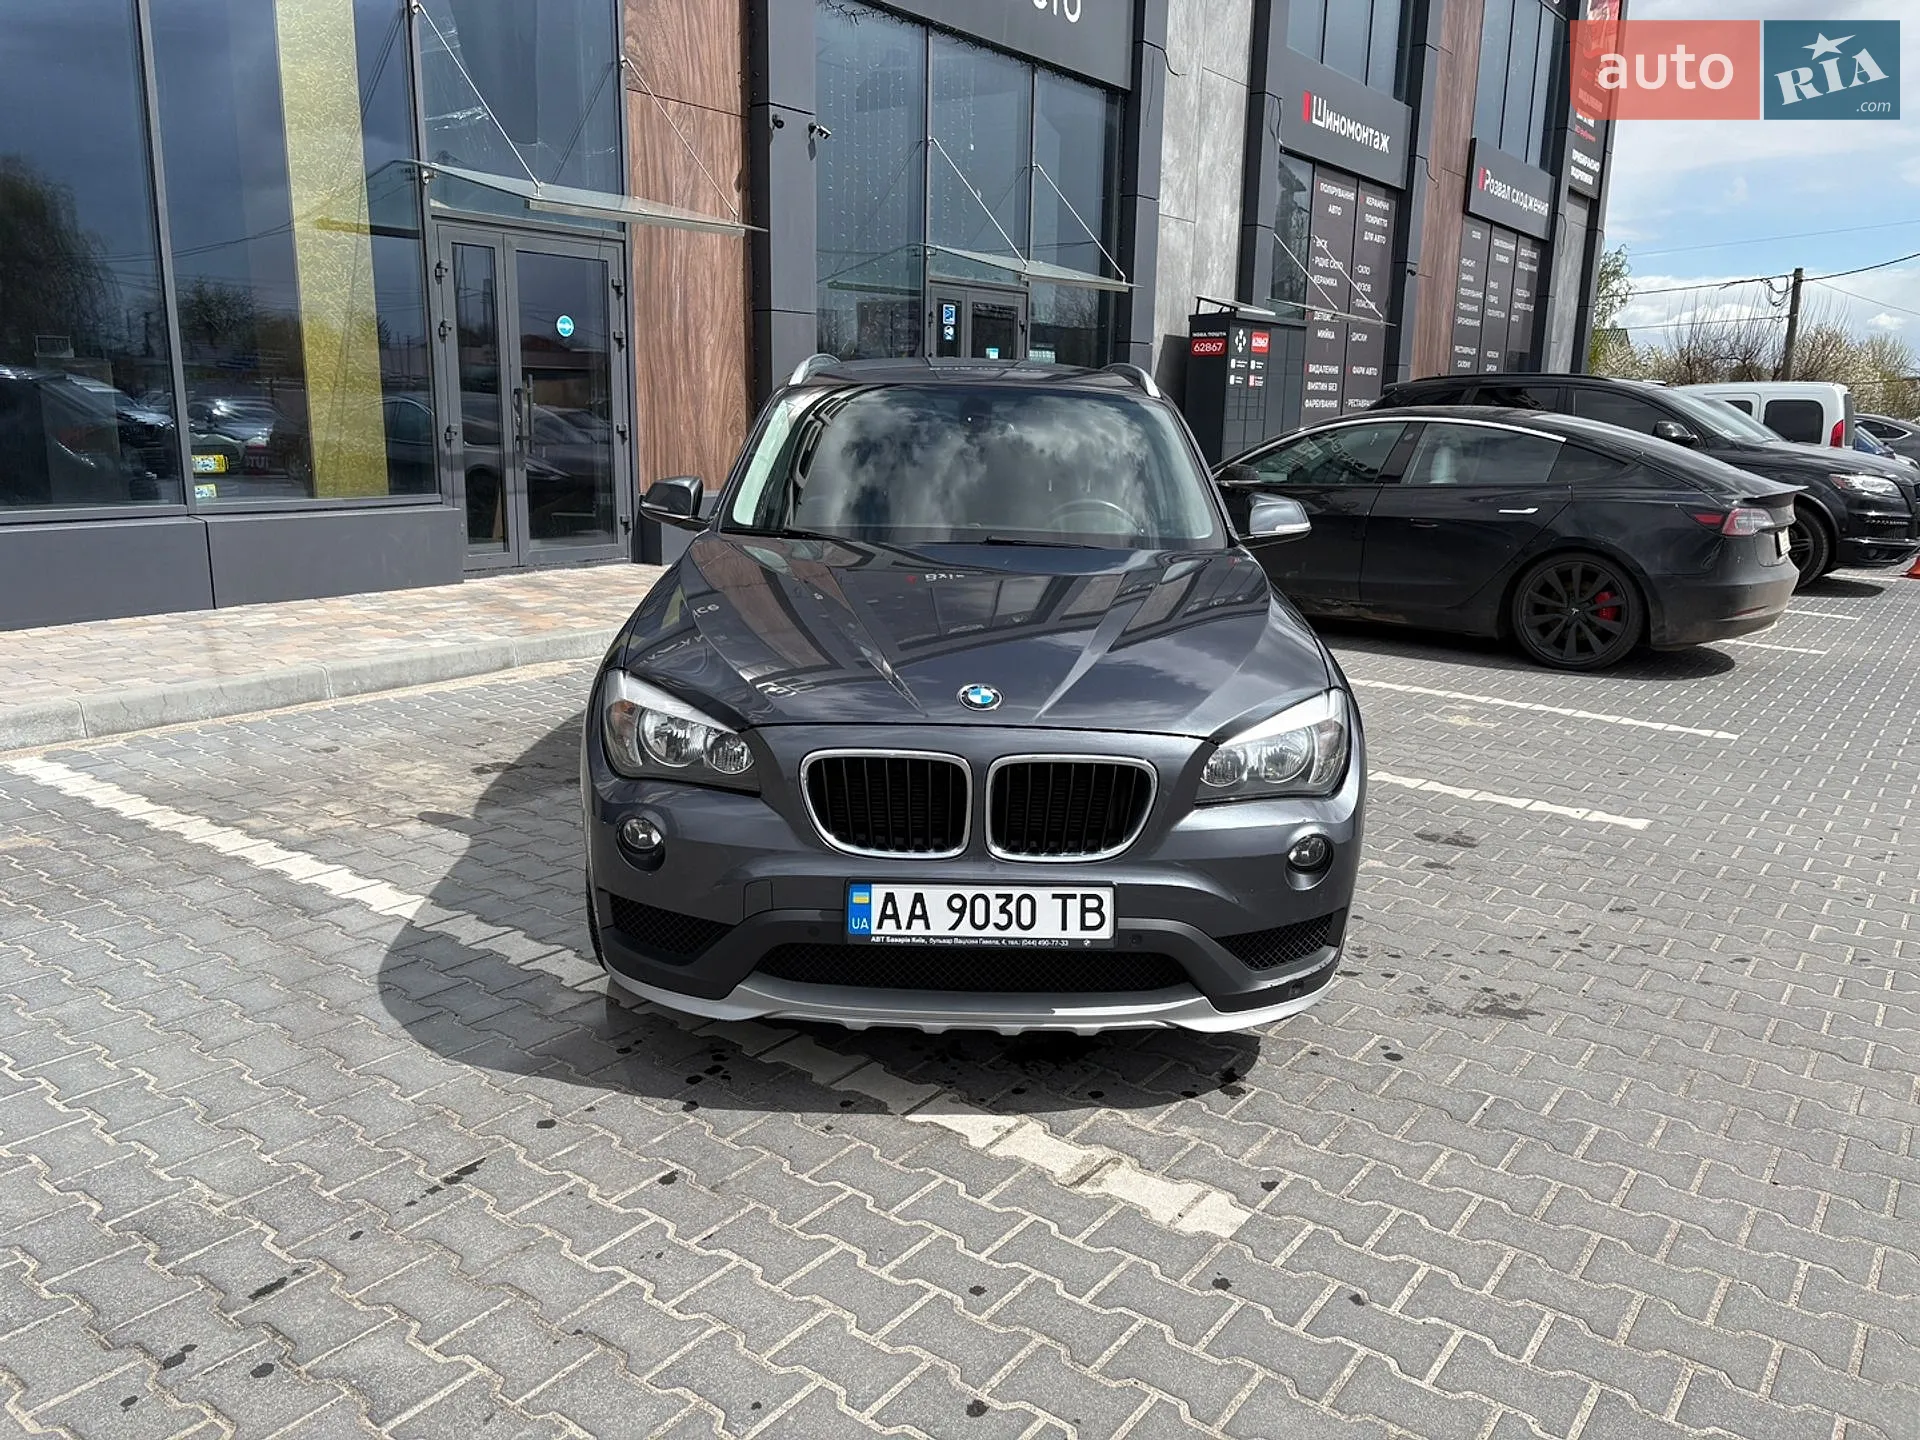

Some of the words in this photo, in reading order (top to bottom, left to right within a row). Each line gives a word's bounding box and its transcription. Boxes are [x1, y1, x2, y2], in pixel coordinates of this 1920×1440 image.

[1312, 95, 1390, 153] Шиномонтаж
[1483, 169, 1510, 200] Розвал
[1511, 188, 1549, 216] сходження
[1328, 204, 1342, 215] АВТО
[1193, 342, 1223, 352] 62867
[1309, 364, 1339, 375] ВИДАЛЕННЯ
[1352, 366, 1365, 375] ФАРИ
[1366, 367, 1378, 376] АВТО
[1328, 382, 1338, 391] БЕЗ
[1304, 399, 1338, 408] ФАРБУВАННЯ
[877, 892, 931, 930] AA
[947, 893, 1036, 931] 9030
[1051, 893, 1106, 931] TB
[852, 917, 869, 929] UA
